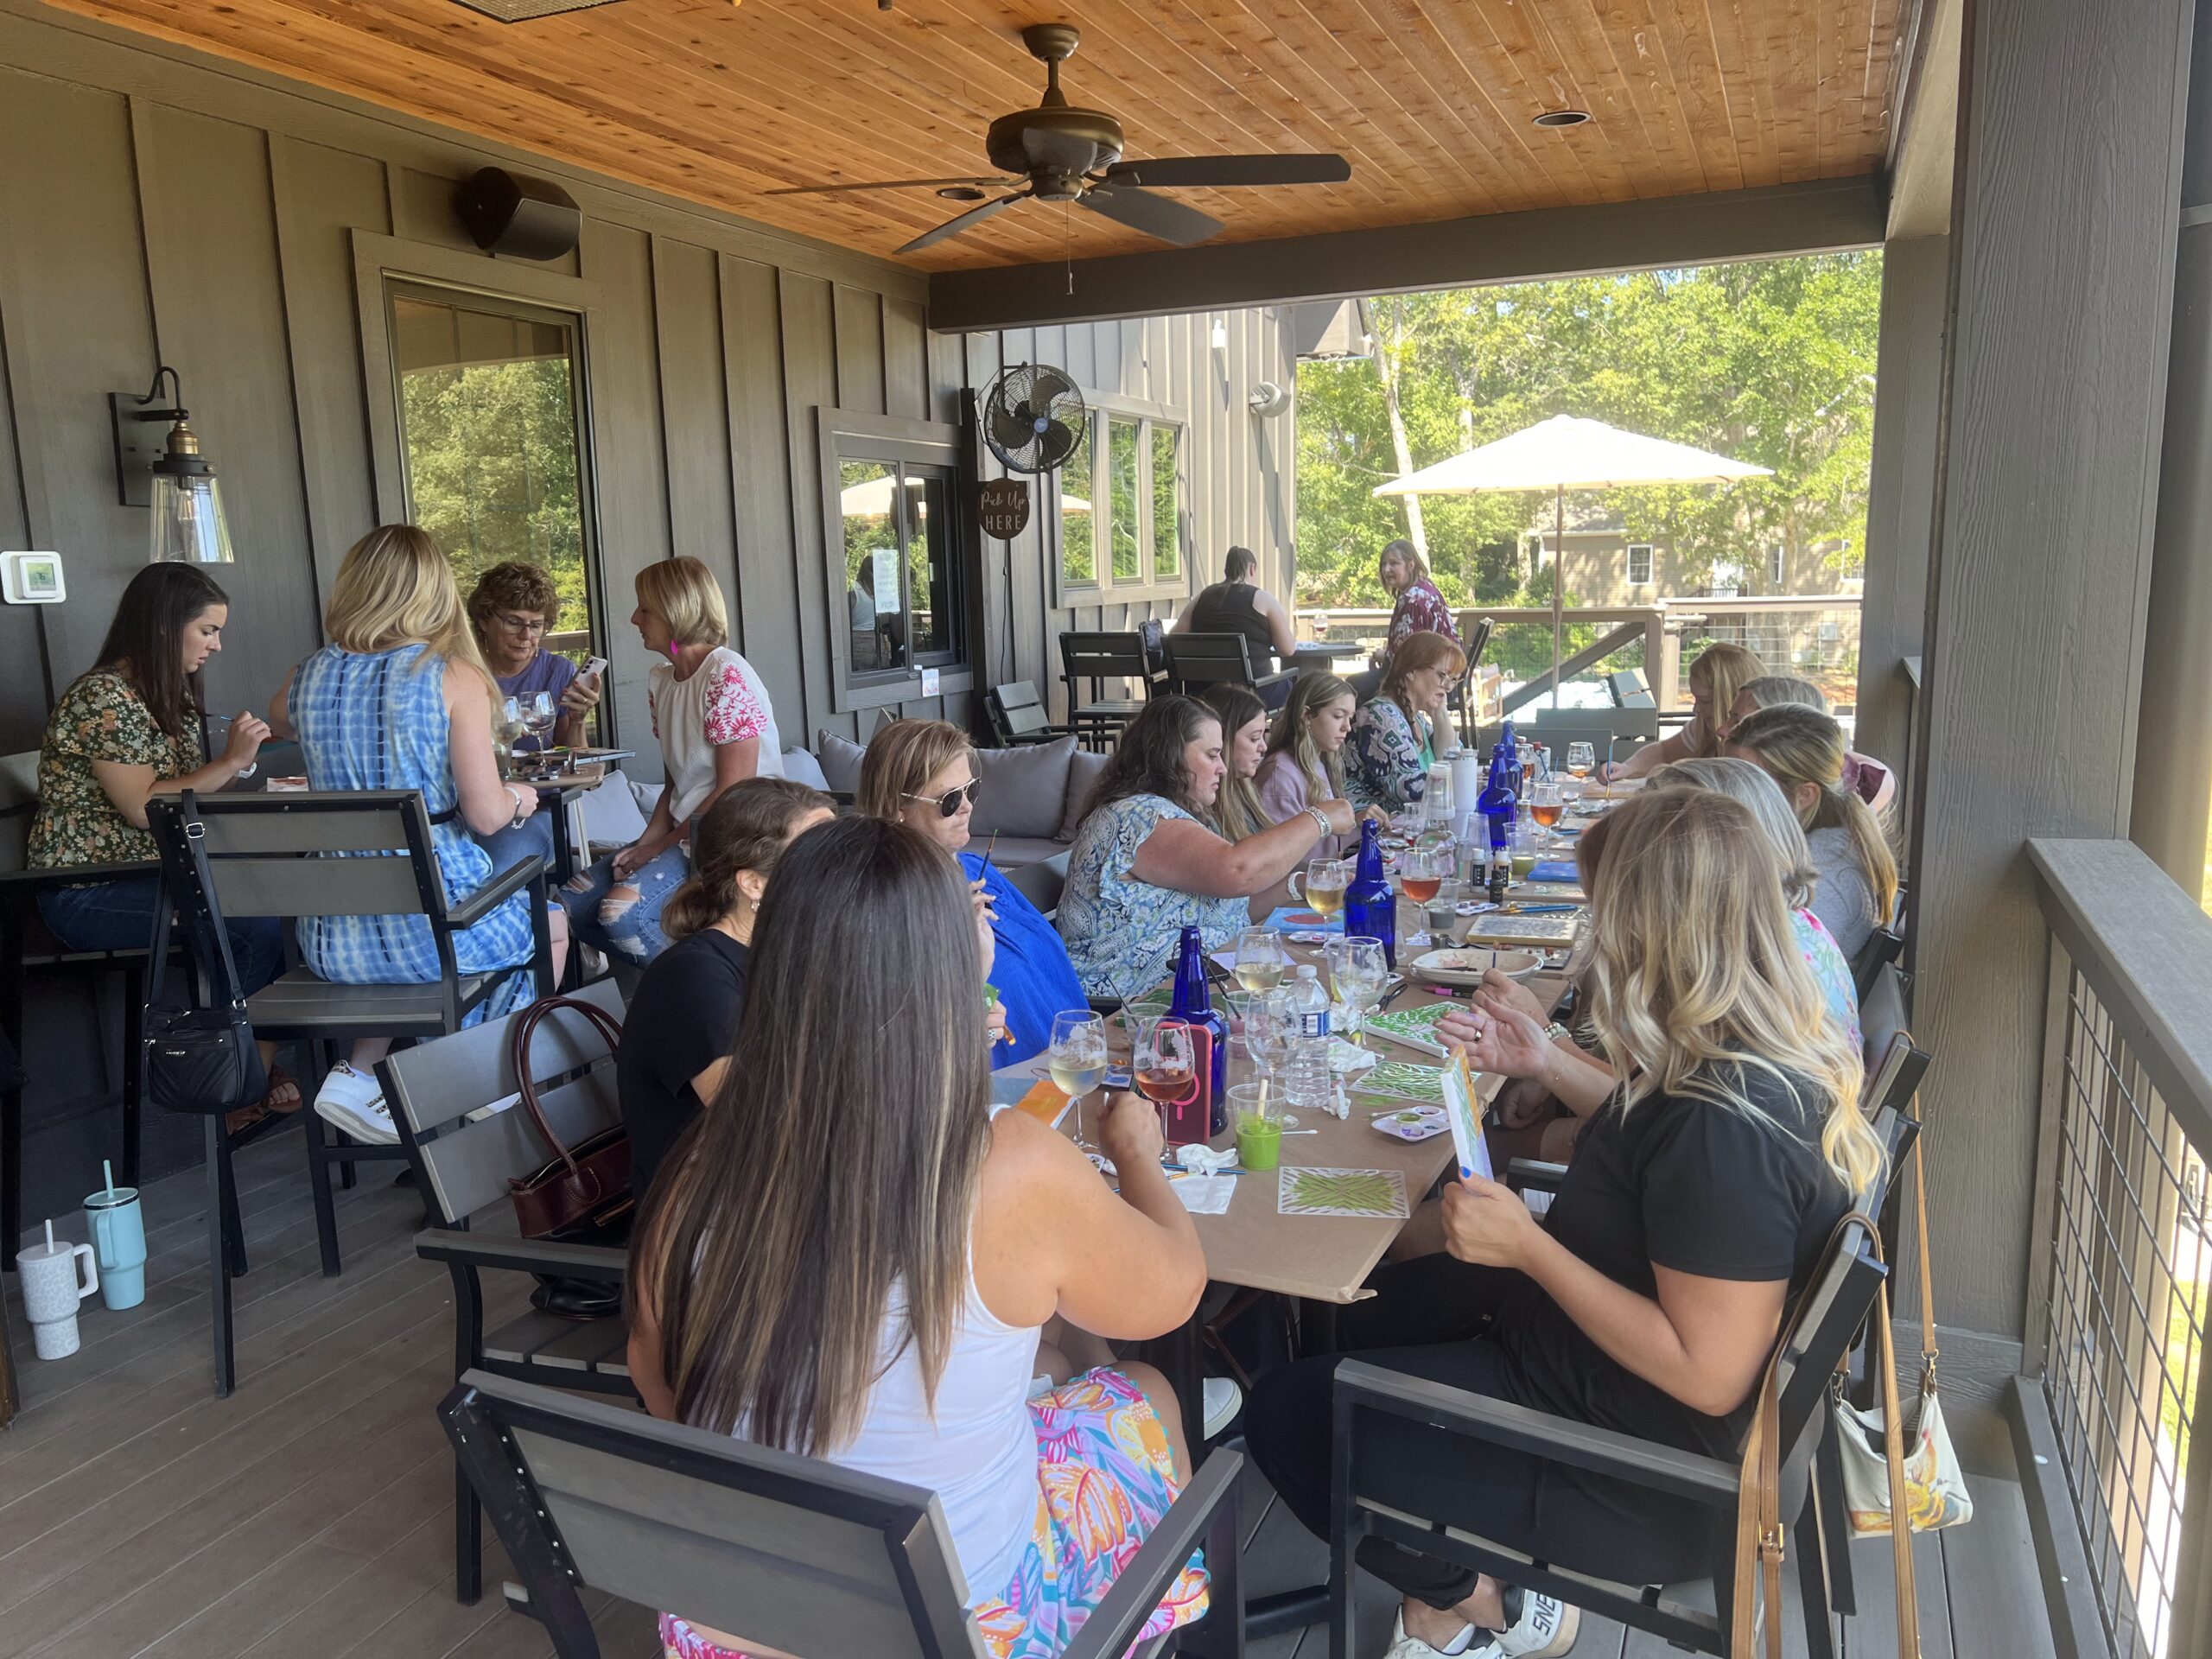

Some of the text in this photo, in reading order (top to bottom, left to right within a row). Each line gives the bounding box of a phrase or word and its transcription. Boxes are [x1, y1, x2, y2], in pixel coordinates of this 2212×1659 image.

[981, 490, 1025, 511] Pick Up
[985, 514, 1021, 531] HERE
